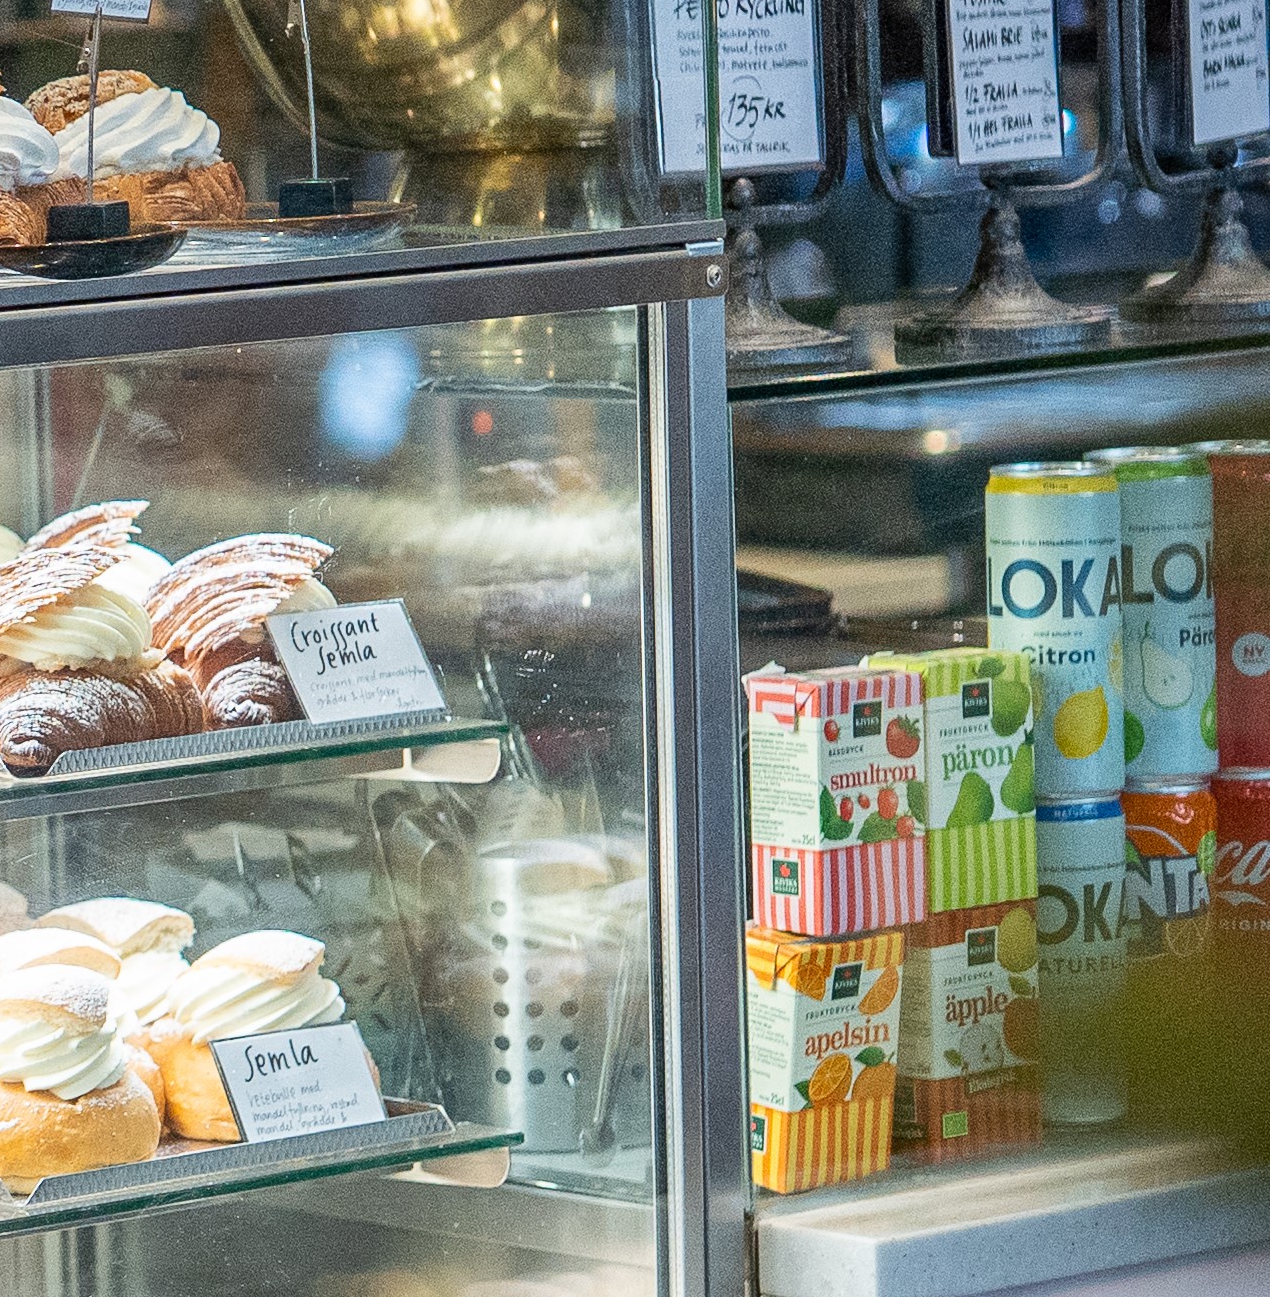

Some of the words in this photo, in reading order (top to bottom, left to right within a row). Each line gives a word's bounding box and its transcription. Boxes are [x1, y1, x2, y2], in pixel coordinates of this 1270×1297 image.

[987, 554, 1122, 619] LOKA
[1121, 540, 1212, 604] LO
[291, 612, 379, 653] Croissant
[317, 641, 377, 675] Semla
[1021, 645, 1096, 665] Citron
[830, 762, 917, 792] smultron
[941, 743, 1013, 781] päron
[945, 985, 1009, 1027] äpple
[805, 1018, 891, 1060] apelsin
[244, 1038, 319, 1083] Semla
